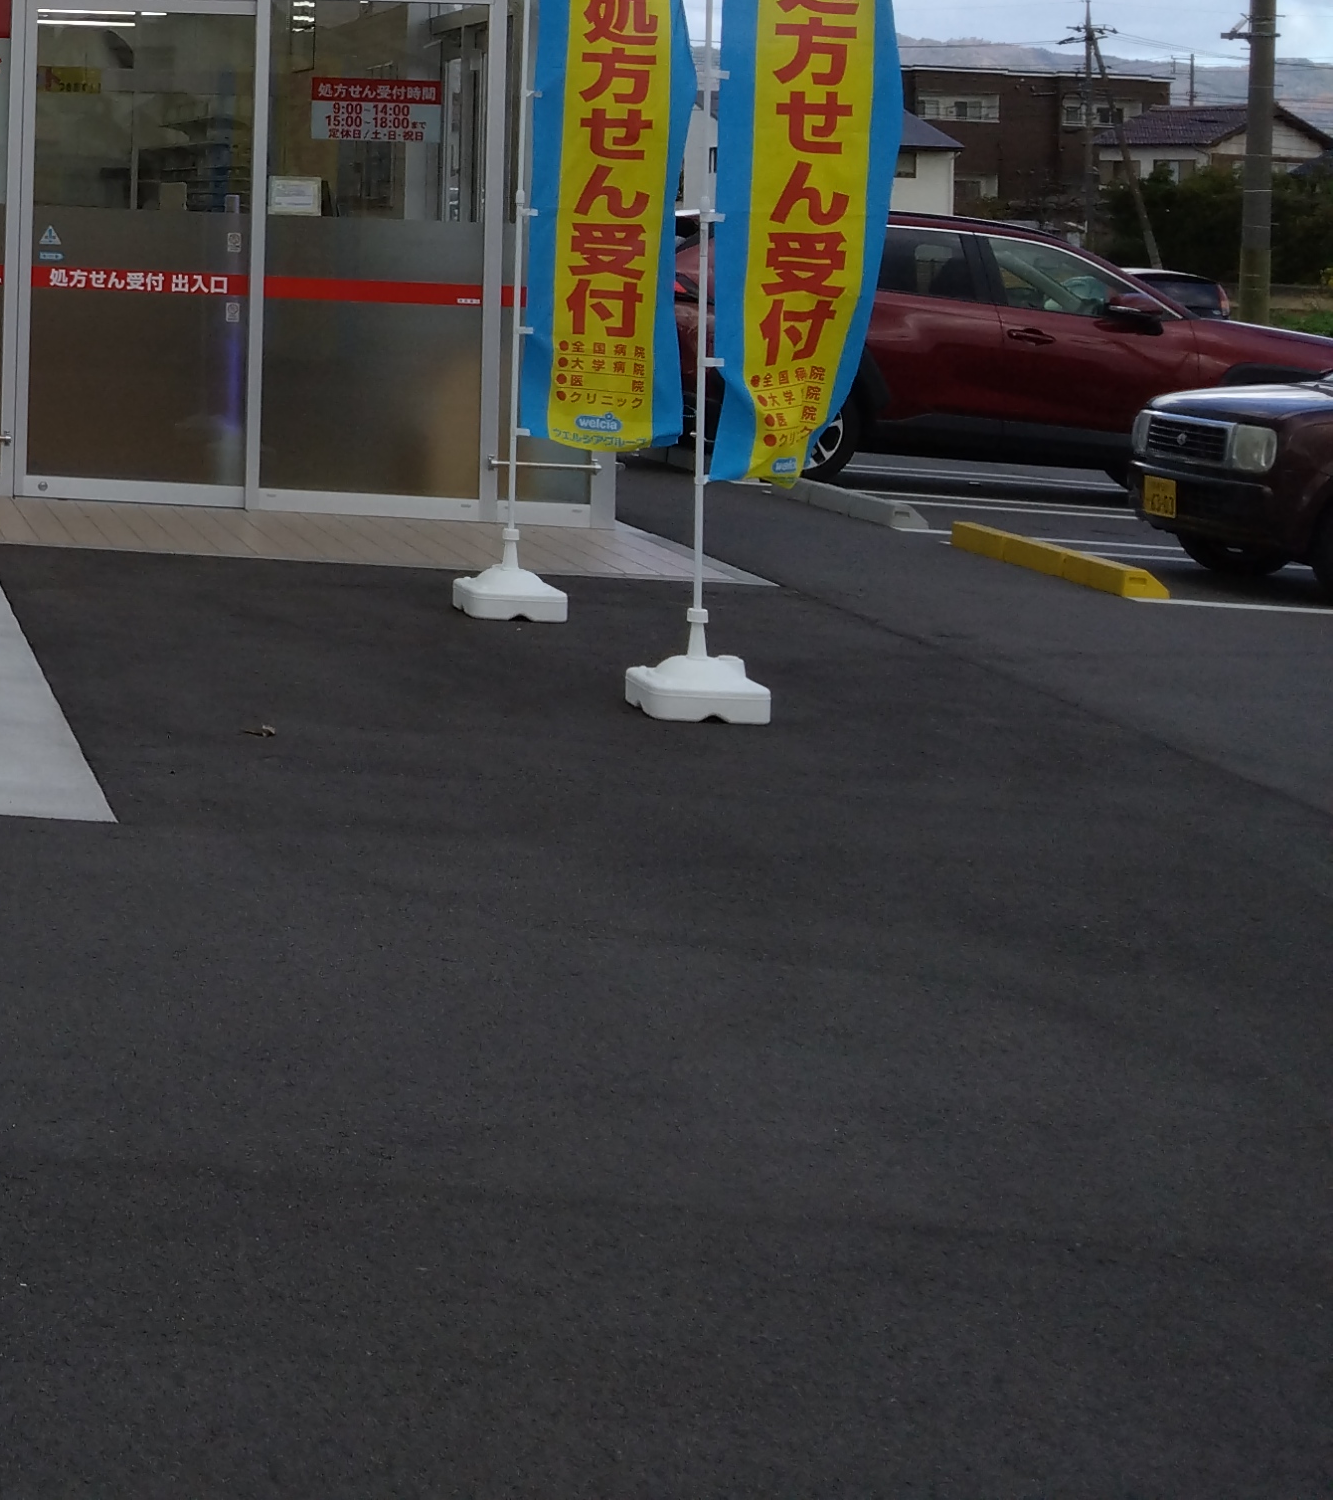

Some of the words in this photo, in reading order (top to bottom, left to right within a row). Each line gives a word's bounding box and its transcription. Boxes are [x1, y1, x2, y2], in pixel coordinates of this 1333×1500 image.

[317, 82, 437, 101] 処方せん受付時間
[48, 267, 166, 292] 処方せん受付
[171, 273, 229, 294] 出入口
[571, 340, 647, 360] 全国病院
[570, 357, 646, 377] 大学病院
[569, 391, 644, 410] クリニック
[767, 385, 822, 407] 大学院
[577, 416, 619, 431] welcia
